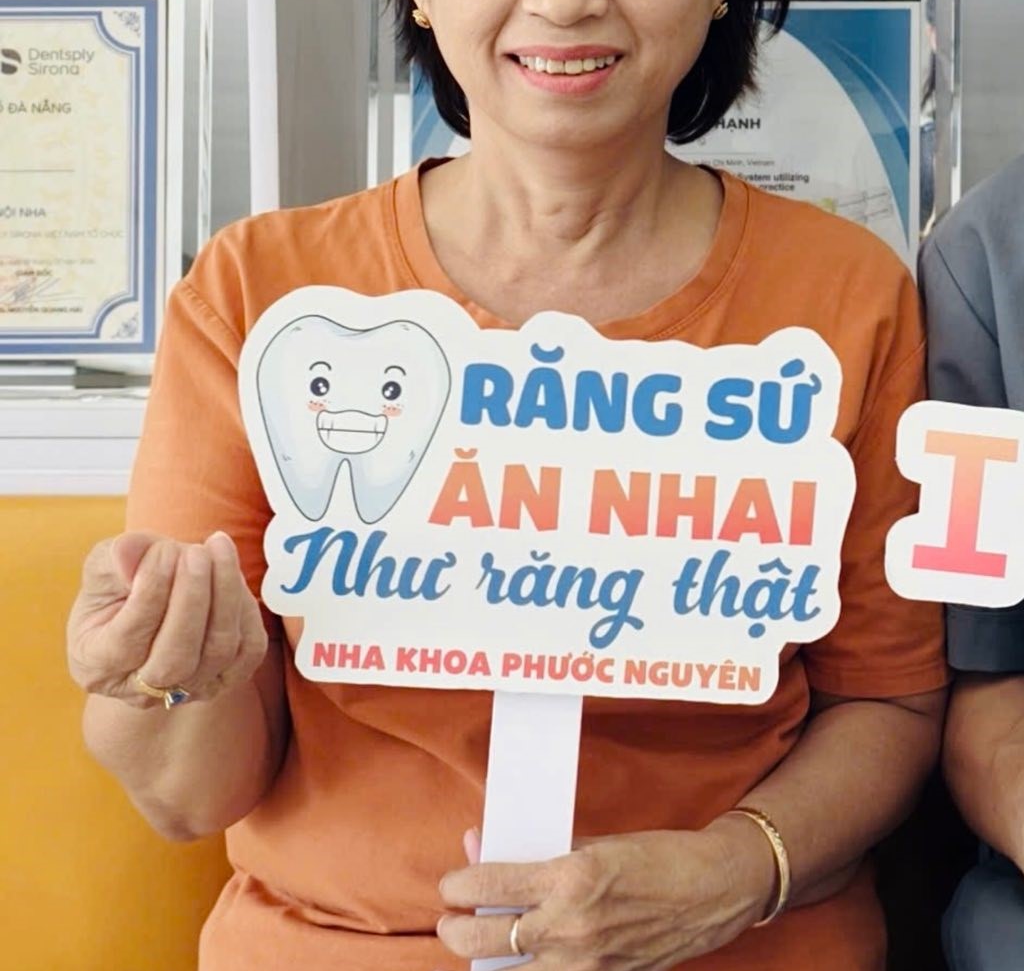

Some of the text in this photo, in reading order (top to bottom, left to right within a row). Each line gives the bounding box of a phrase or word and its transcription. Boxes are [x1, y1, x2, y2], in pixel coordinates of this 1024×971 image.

[28, 47, 95, 64] Dentsply
[28, 63, 80, 75] Sirona
[459, 342, 822, 444] RĂNG SỨ
[428, 447, 818, 547] ĂN NHAI
[911, 429, 1020, 579] I
[279, 526, 822, 650] Như răng thật
[311, 641, 762, 692] NHA KHOA PHƯỚC NGUYÊN
